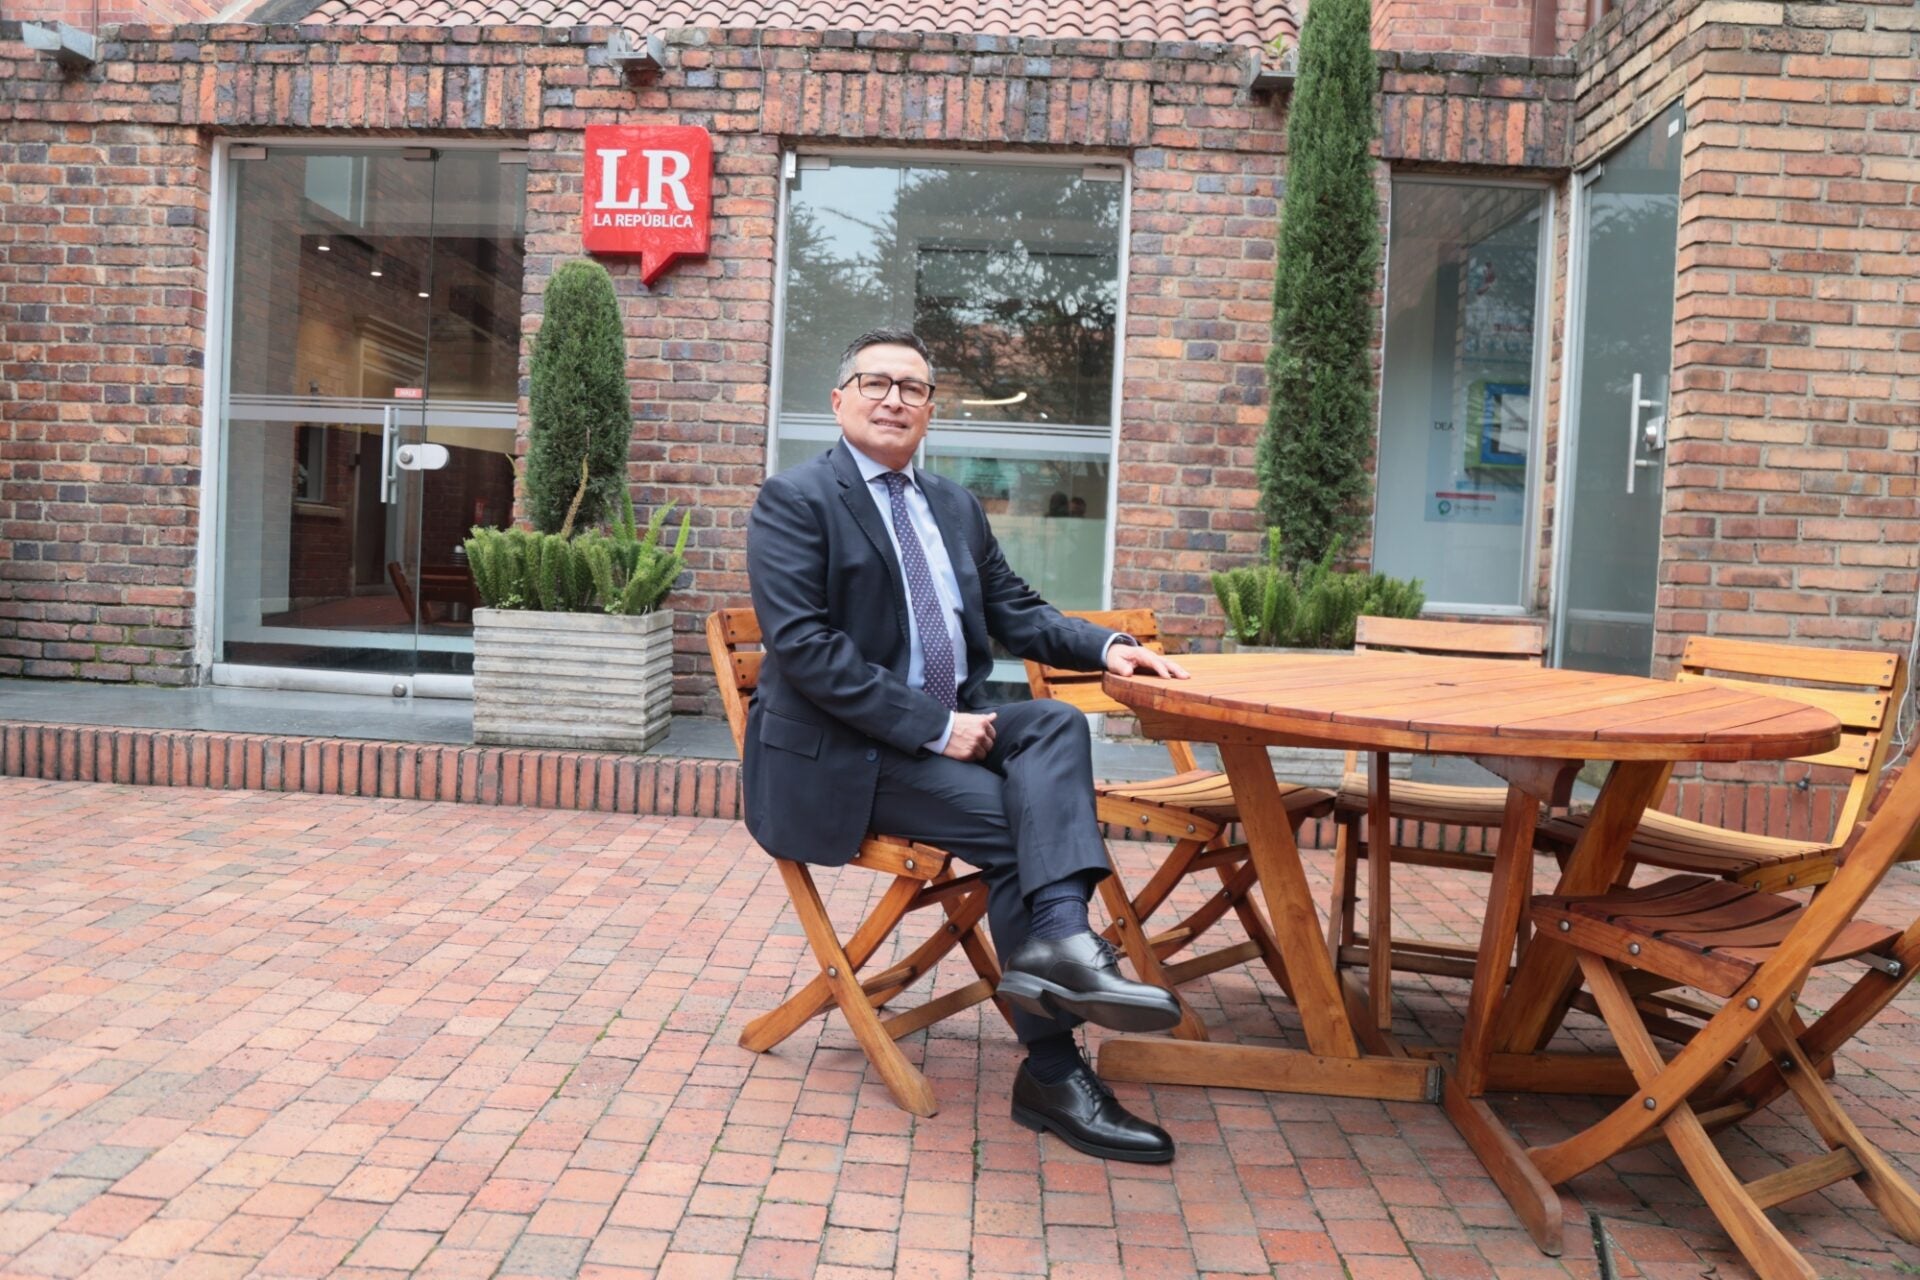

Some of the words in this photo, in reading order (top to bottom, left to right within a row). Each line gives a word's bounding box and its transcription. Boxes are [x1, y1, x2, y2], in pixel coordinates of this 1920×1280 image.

[595, 148, 695, 211] LR
[593, 213, 612, 227] LA
[615, 211, 694, 228] REPÚBLICA
